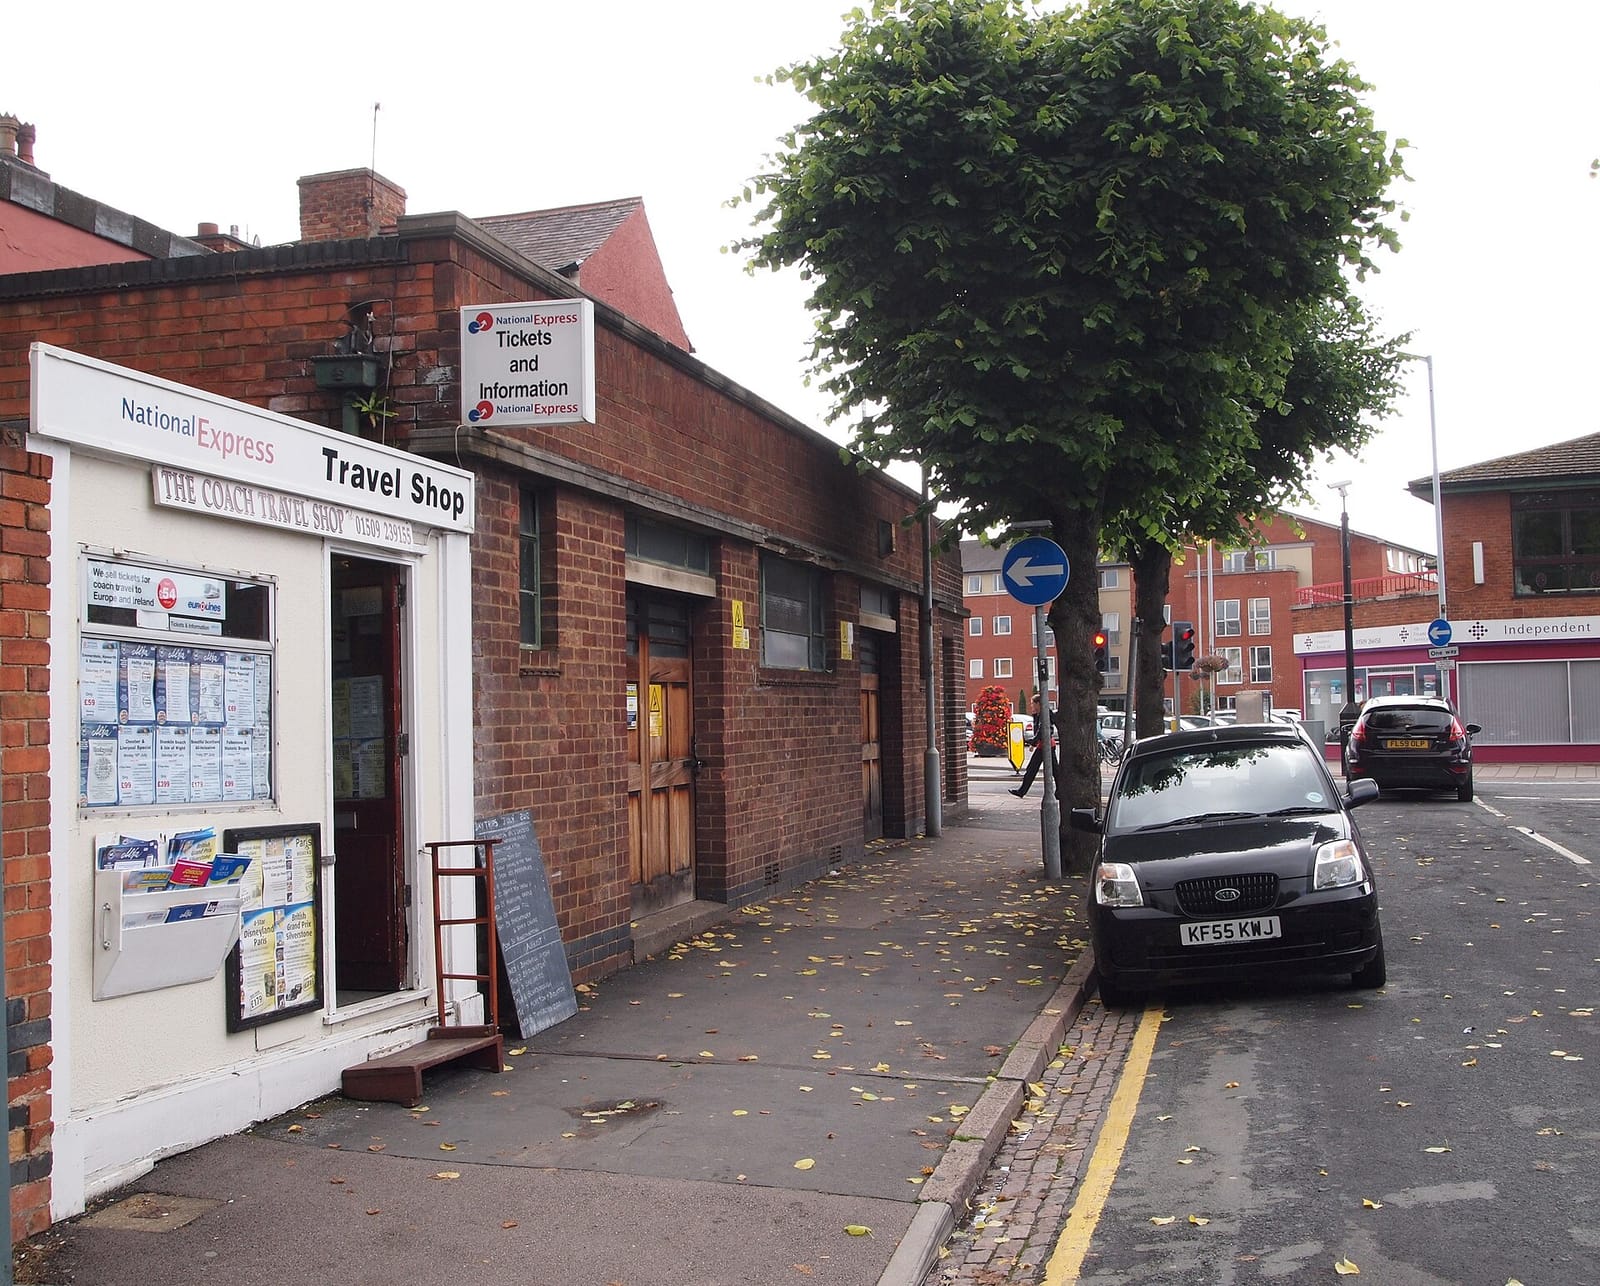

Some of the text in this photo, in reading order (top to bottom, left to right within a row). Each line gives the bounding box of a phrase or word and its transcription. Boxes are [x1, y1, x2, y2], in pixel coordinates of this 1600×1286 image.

[496, 329, 552, 348] Tickets
[509, 354, 539, 373] and
[479, 379, 568, 400] Information
[321, 447, 465, 521] Travel Shop
[161, 469, 413, 546] THE COACH TRAVEL SHOP 01509 239155
[92, 567, 105, 578] We
[118, 572, 140, 583] tickets
[141, 574, 151, 584] for
[92, 580, 115, 591] coach
[135, 585, 142, 594] to
[93, 591, 118, 603] Europe
[132, 597, 155, 607] Ireland
[1503, 622, 1592, 637] Independent
[1188, 919, 1274, 942] KF55 KWJ
